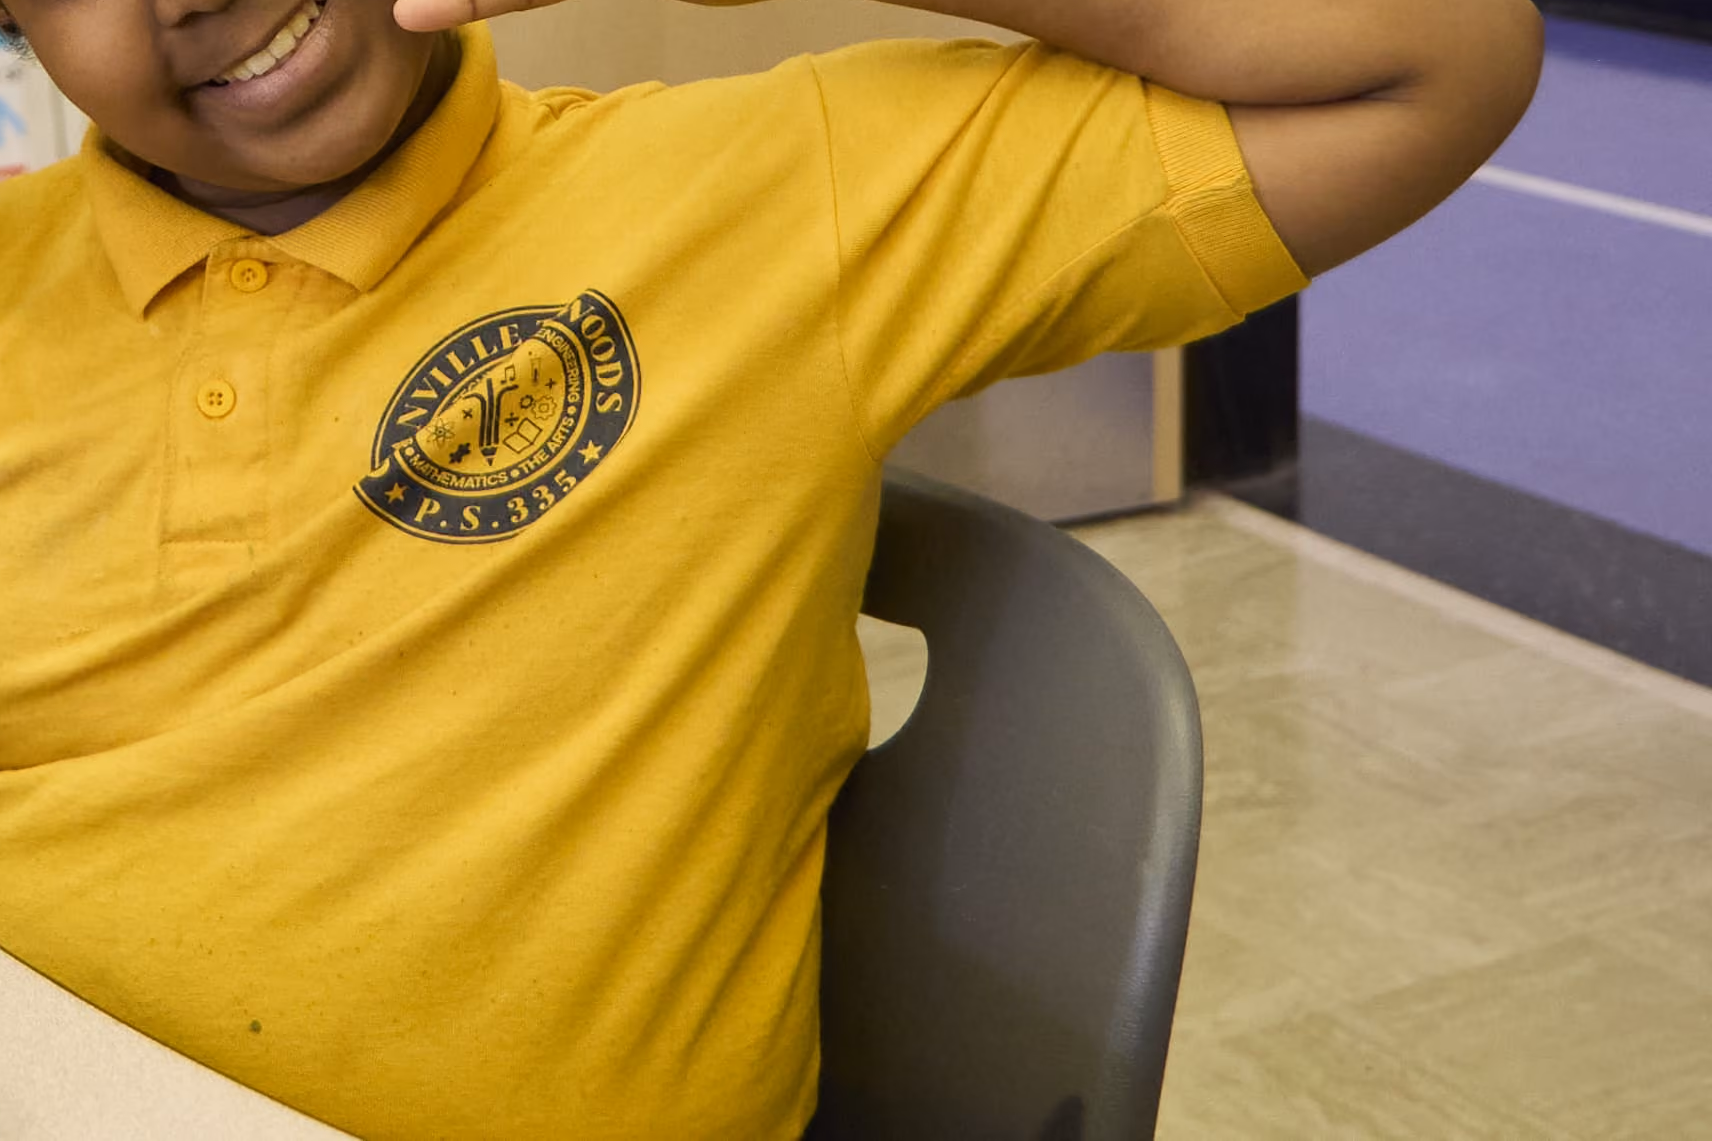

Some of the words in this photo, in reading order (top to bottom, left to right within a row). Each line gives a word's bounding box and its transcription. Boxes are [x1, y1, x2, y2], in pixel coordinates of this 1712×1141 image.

[517, 452, 553, 476] THE
[548, 415, 578, 455] ARTS
[409, 452, 509, 489] MATHEMATICS
